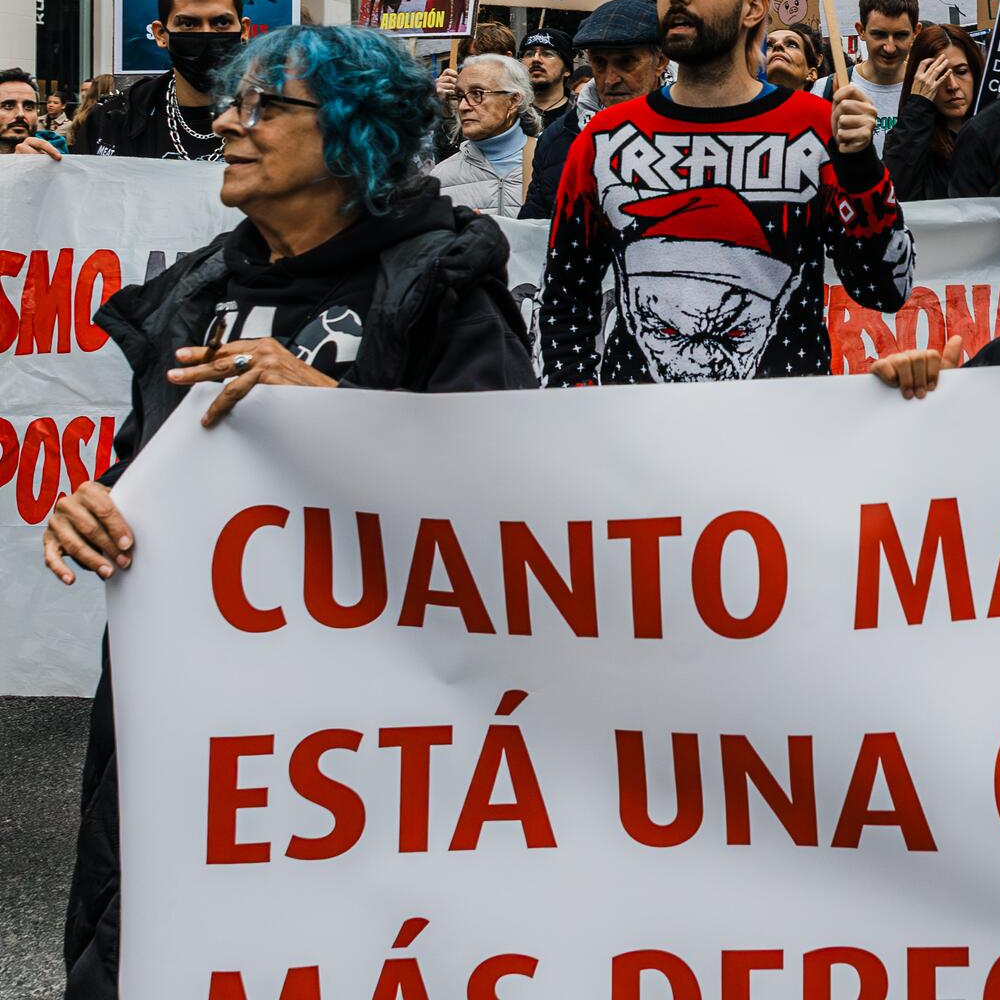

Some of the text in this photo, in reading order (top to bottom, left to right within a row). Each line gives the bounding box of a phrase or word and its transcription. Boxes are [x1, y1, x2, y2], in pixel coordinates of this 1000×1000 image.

[380, 10, 446, 30] ABOLICIÓN
[594, 122, 831, 202] KREATOR
[211, 506, 788, 638] CUANTO
[208, 689, 557, 865] ESTÁ
[614, 728, 939, 852] UNA
